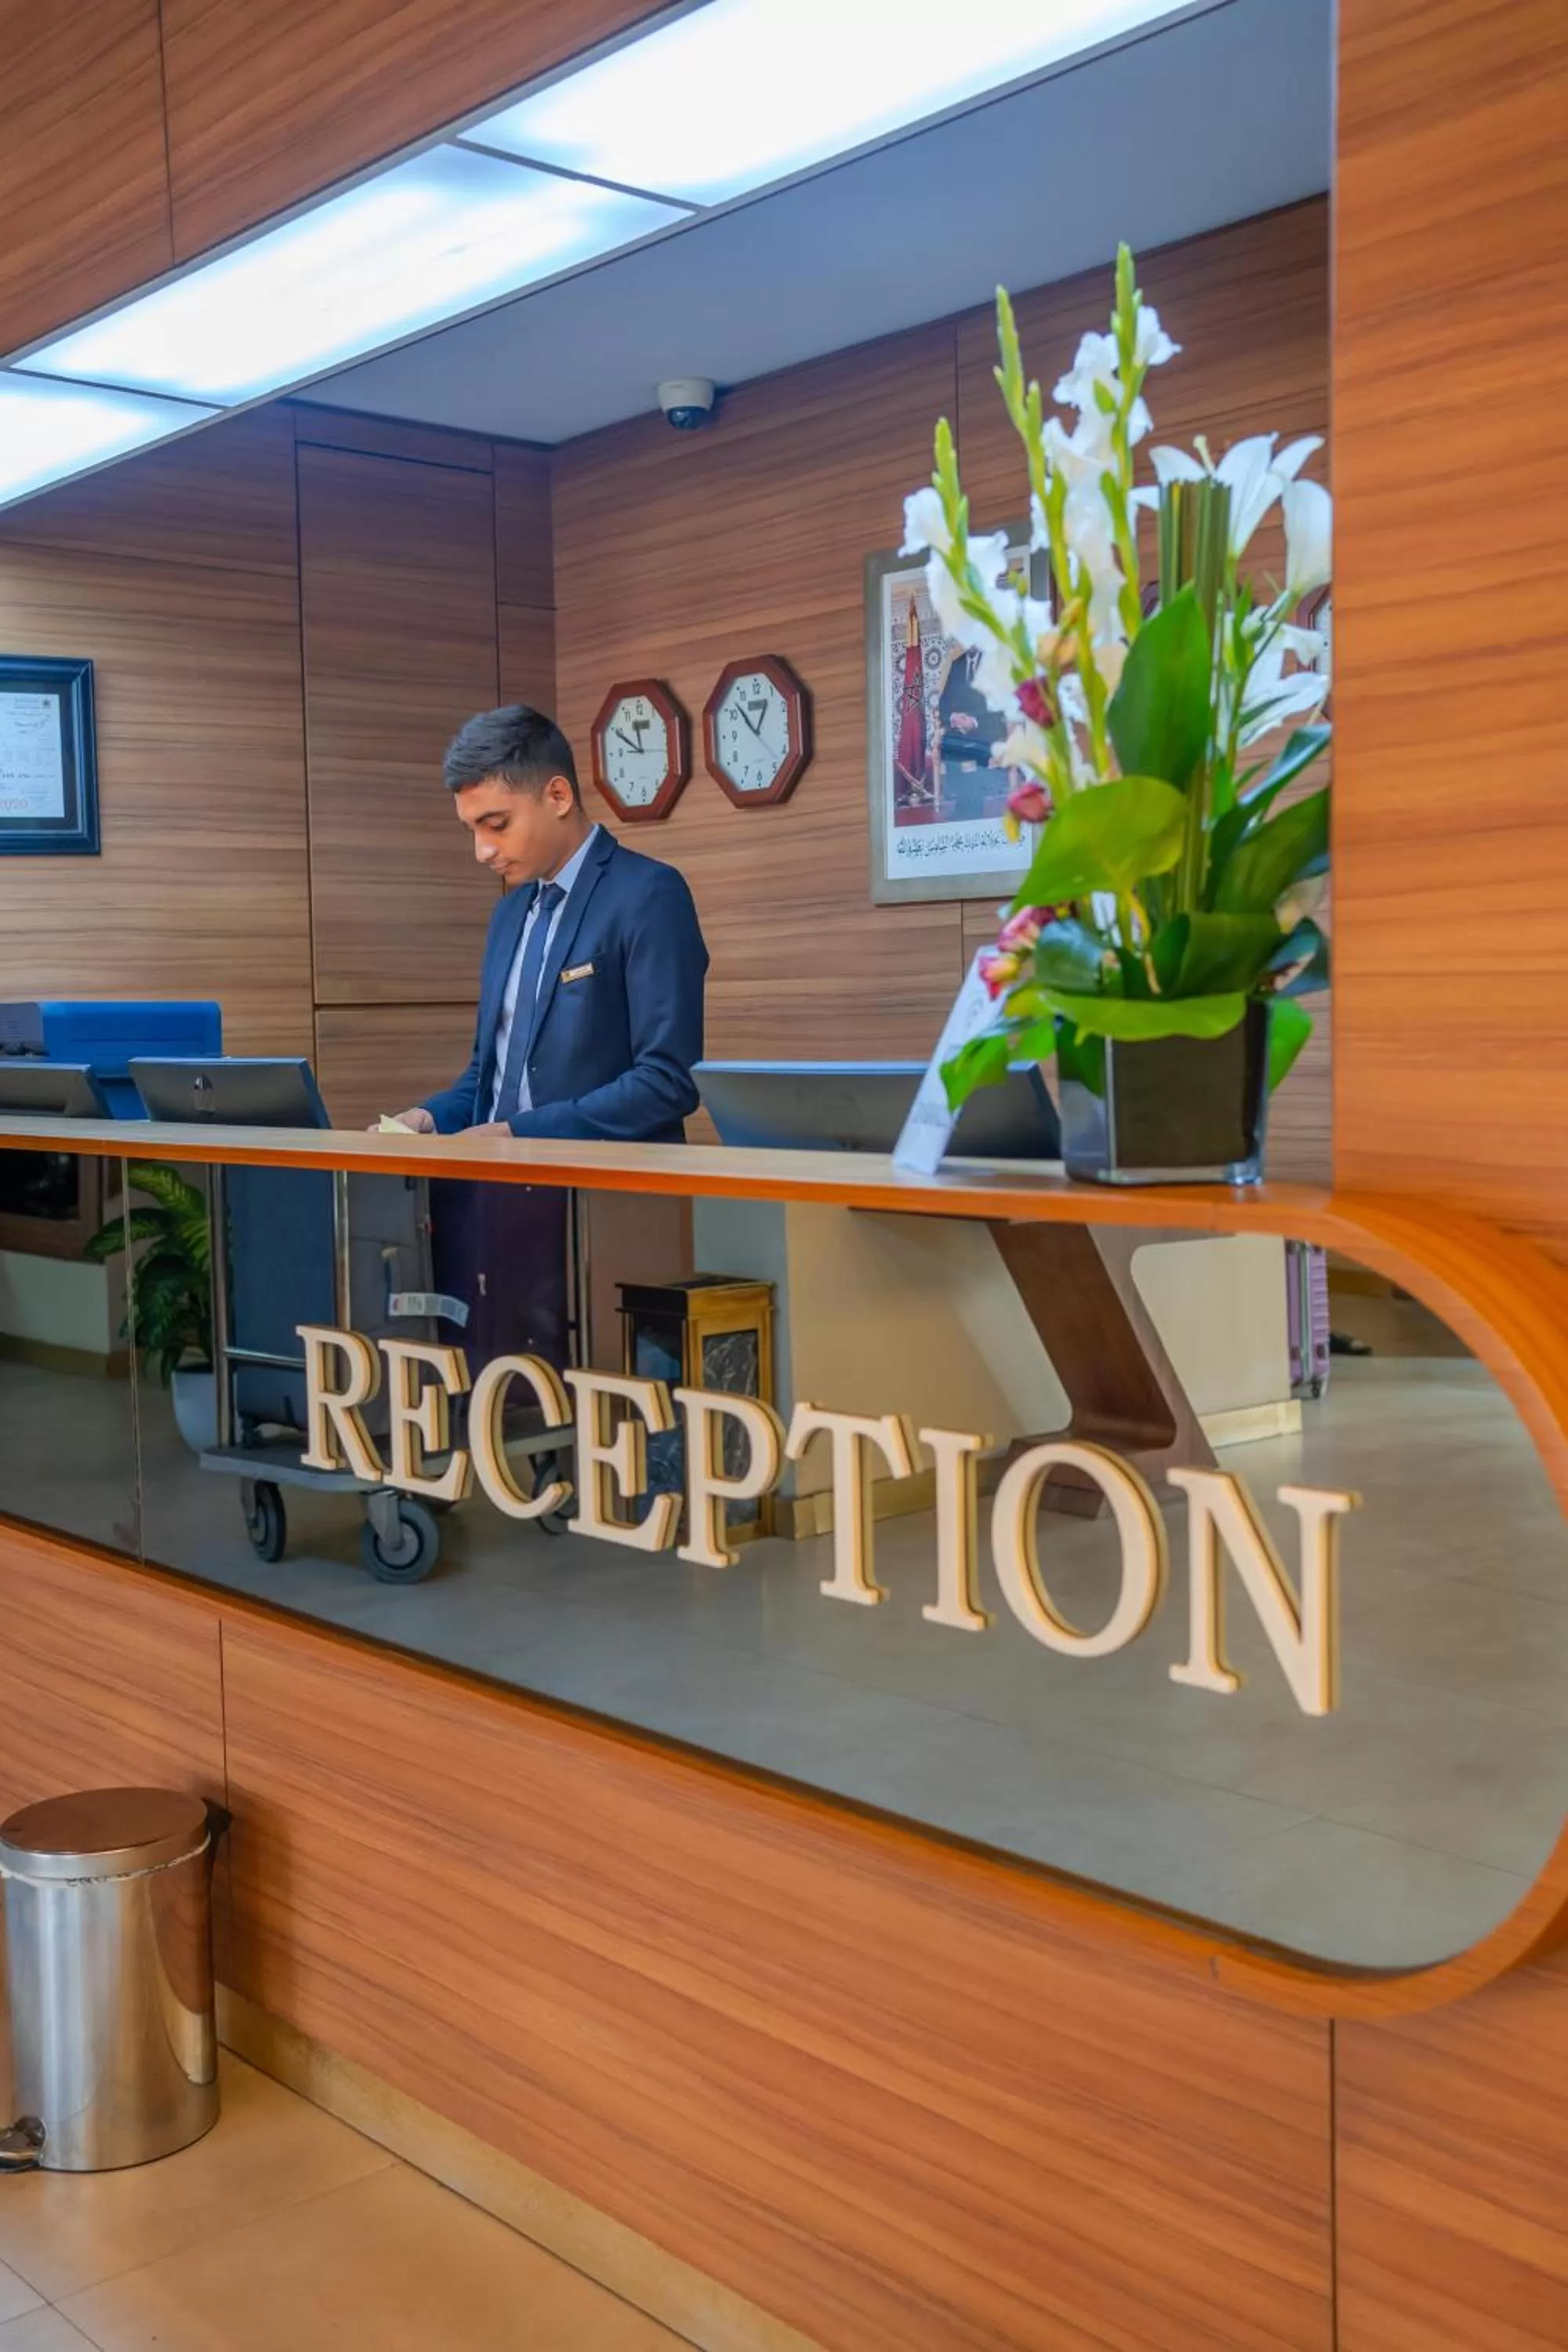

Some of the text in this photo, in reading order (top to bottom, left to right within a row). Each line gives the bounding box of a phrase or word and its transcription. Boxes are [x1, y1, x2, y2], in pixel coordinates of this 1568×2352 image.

[753, 682, 761, 695] 12
[731, 730, 738, 742] 9
[743, 765, 750, 777] 7
[757, 770, 763, 782] 6
[296, 1323, 1362, 1716] RECEPTION
